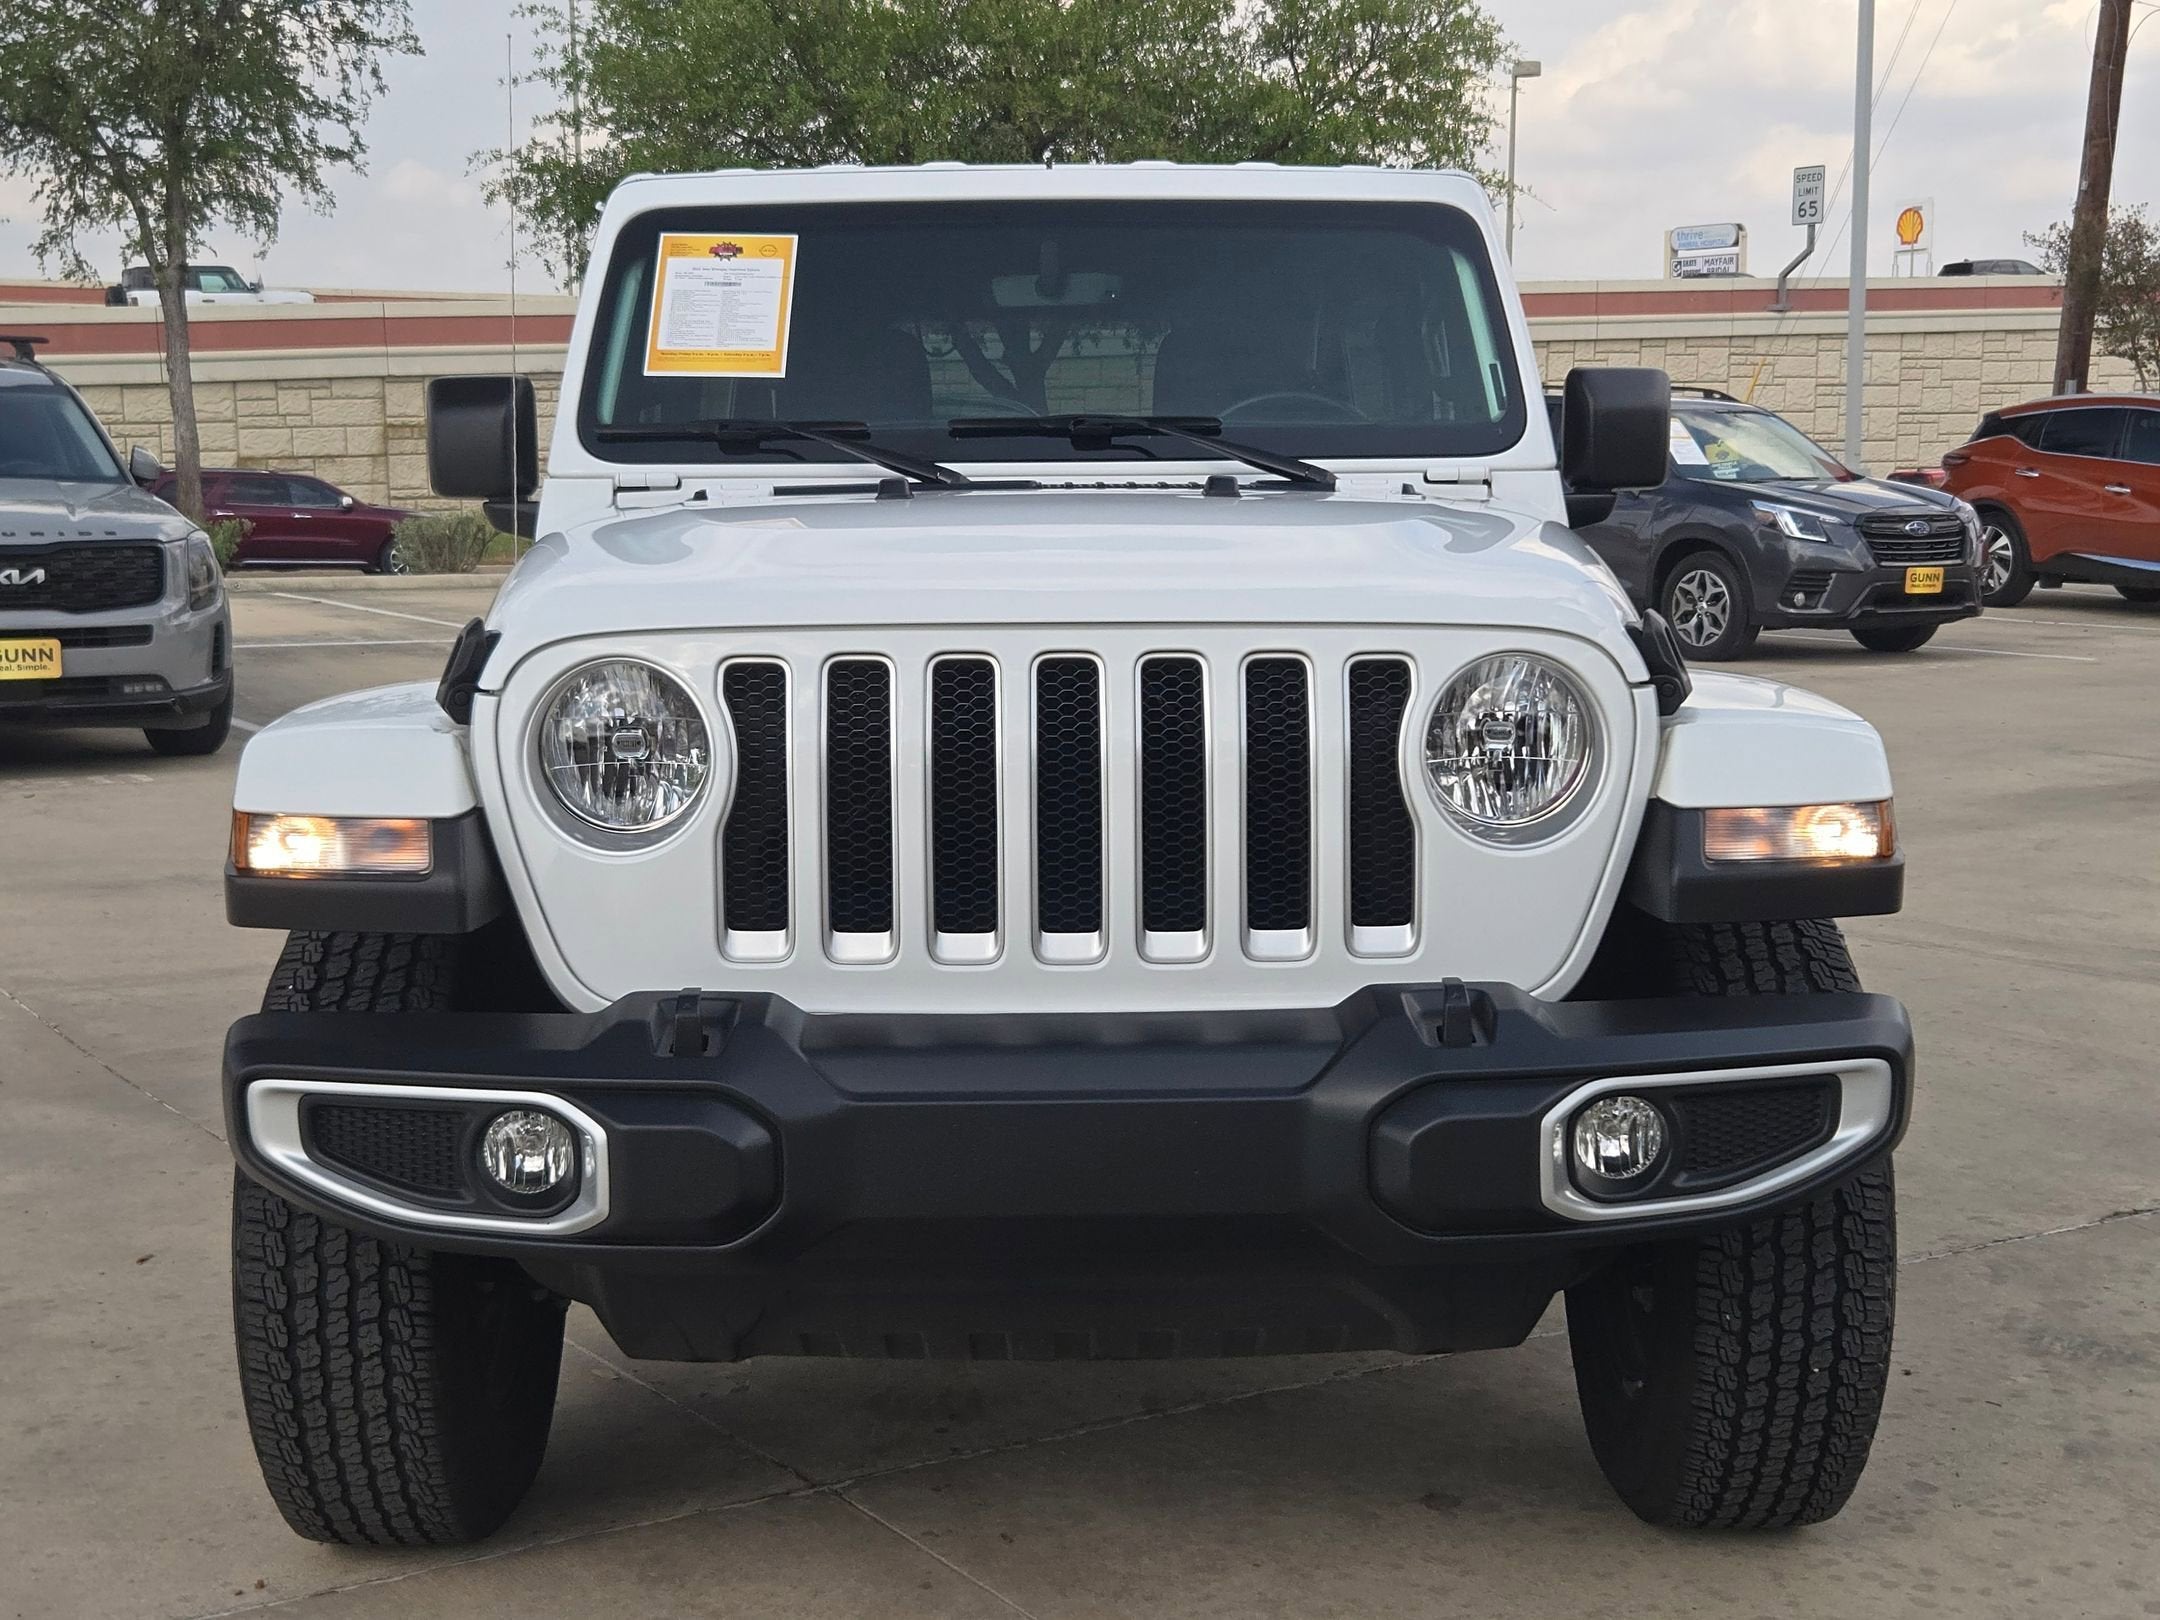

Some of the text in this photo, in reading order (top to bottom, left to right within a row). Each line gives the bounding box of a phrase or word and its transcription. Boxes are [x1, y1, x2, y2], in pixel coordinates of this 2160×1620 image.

[1796, 172, 1823, 183] SPEED
[1798, 186, 1819, 197] LIMIT
[1797, 200, 1818, 218] 65
[1703, 256, 1735, 267] MAYFAIR
[1910, 572, 1940, 583] GUNN
[0, 647, 54, 663] UNN
[17, 664, 51, 672] Simple.
